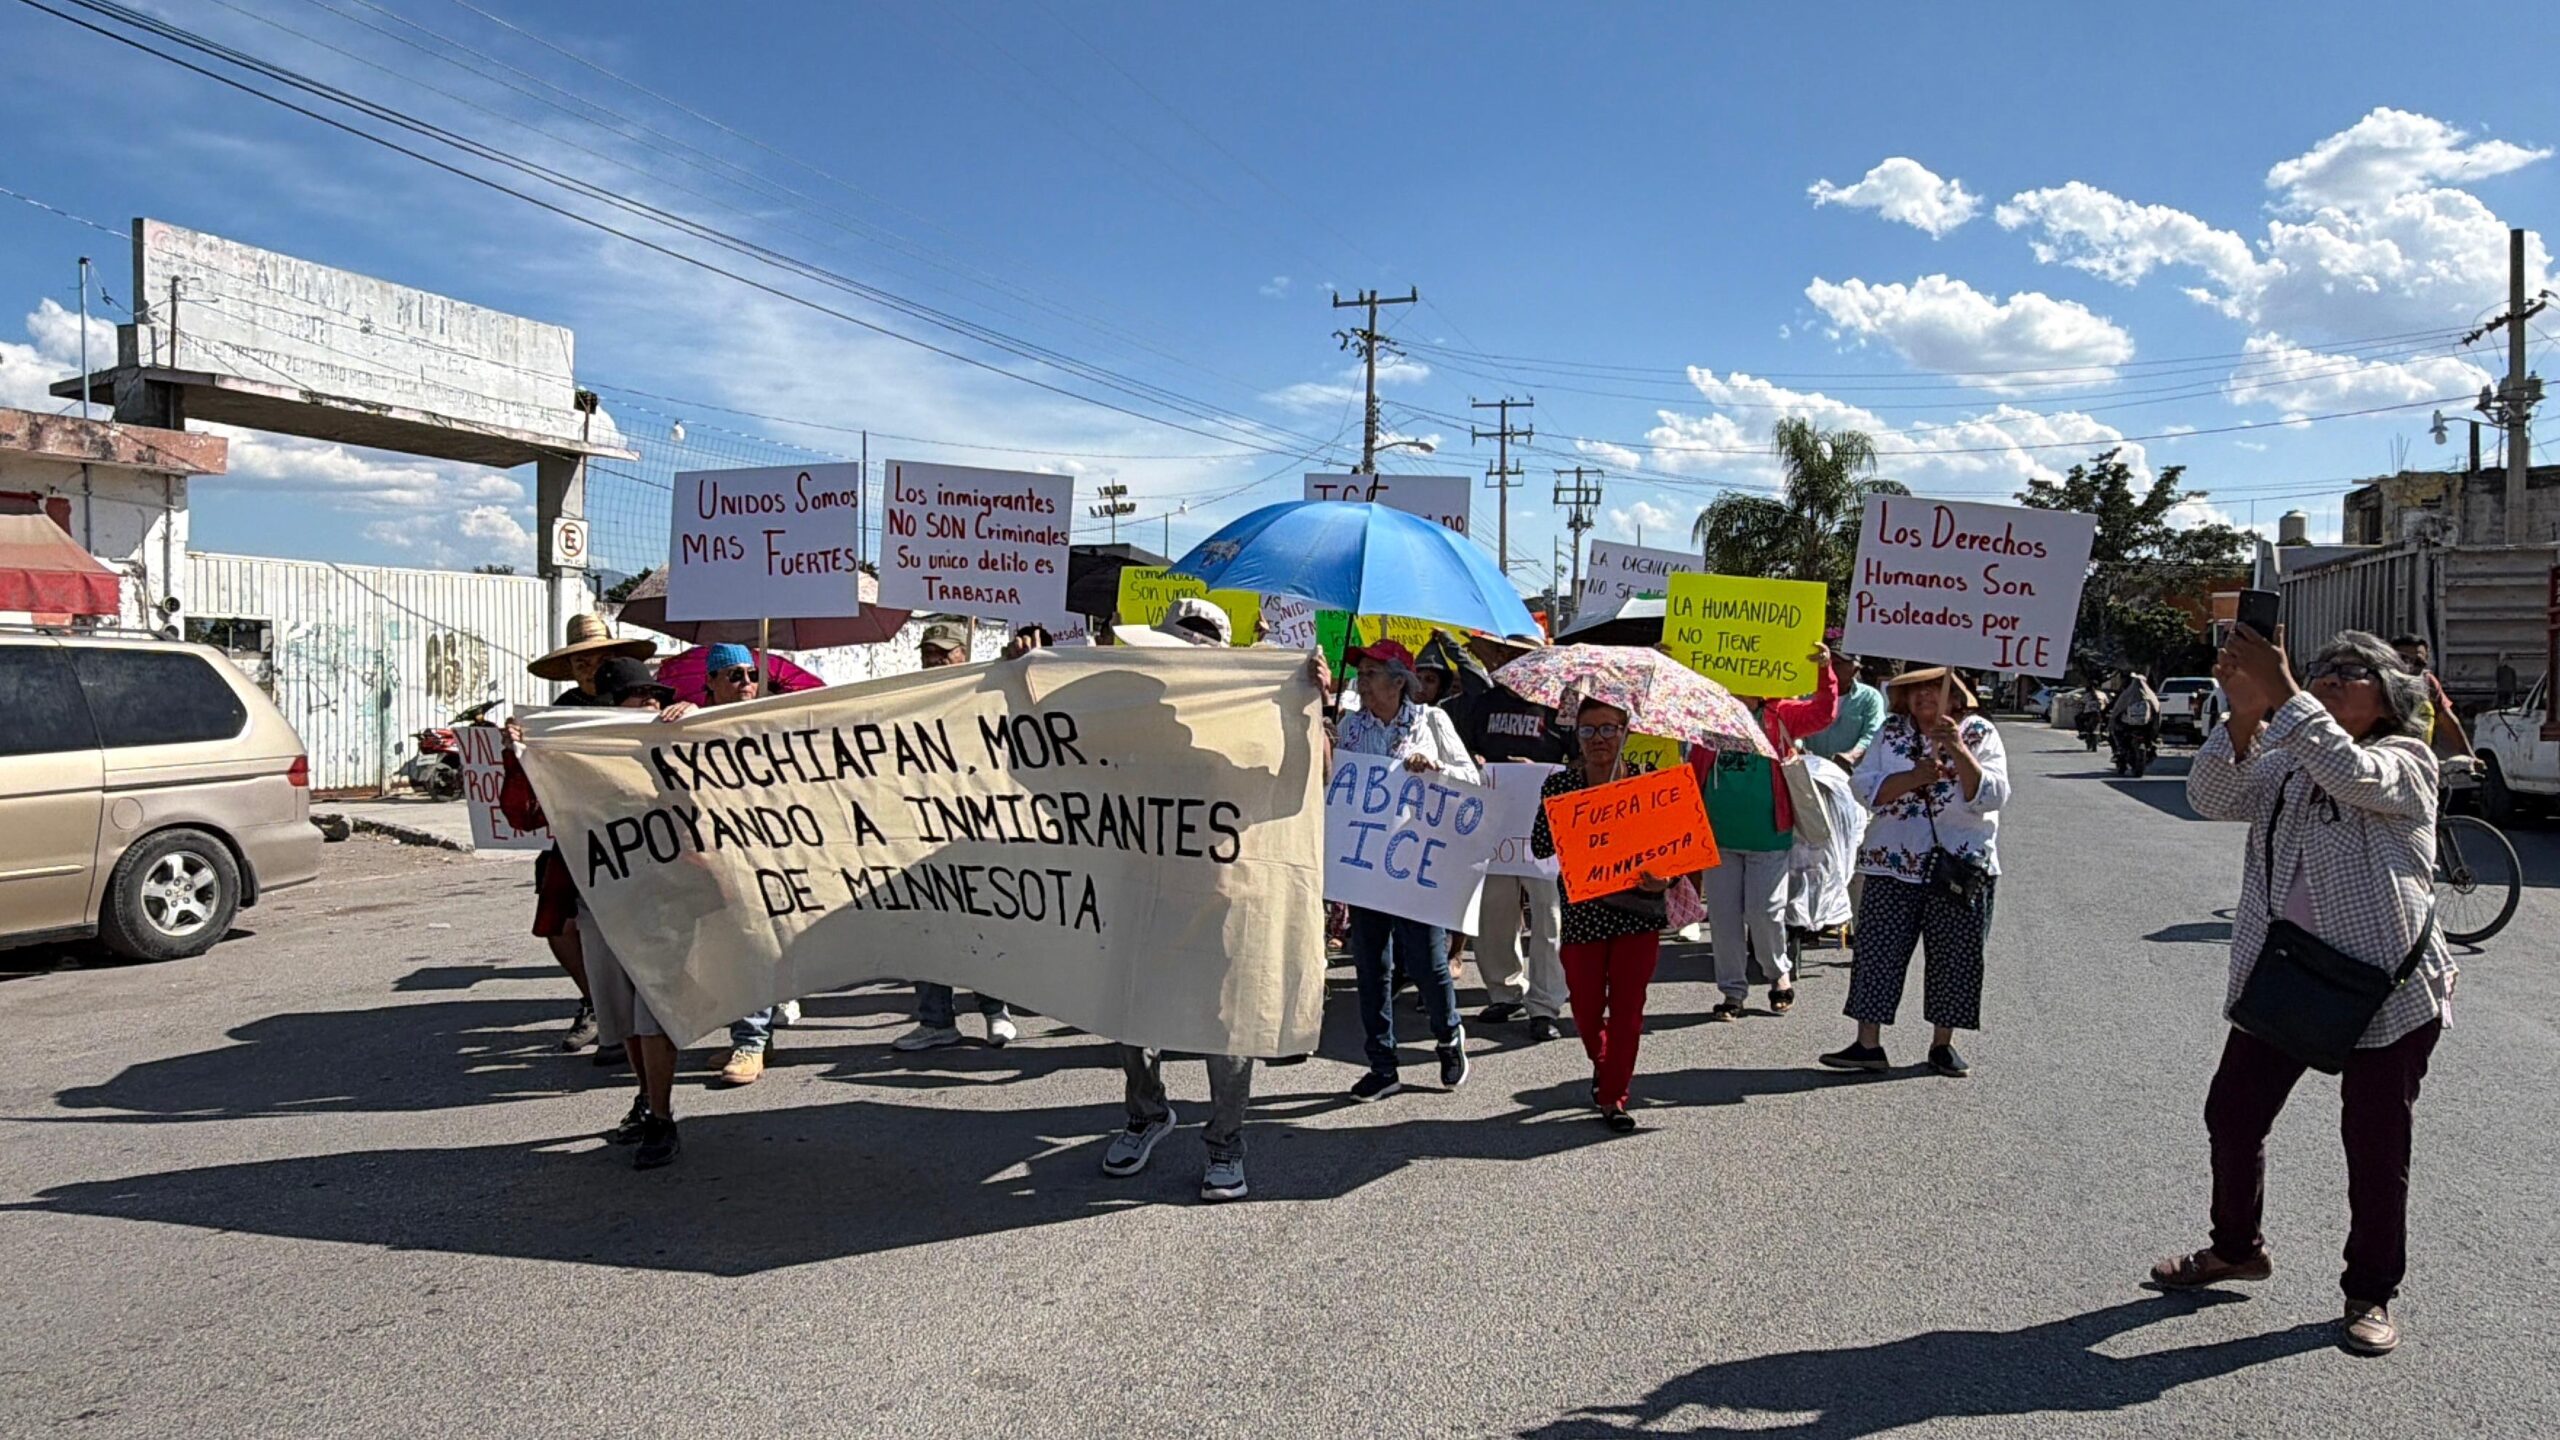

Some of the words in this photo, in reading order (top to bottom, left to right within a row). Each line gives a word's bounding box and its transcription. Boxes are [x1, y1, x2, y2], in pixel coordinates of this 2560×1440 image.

[699, 479, 786, 520] UNIDOS
[895, 466, 928, 505] Los
[937, 483, 1055, 517] inmigrantes
[889, 508, 917, 537] NO
[926, 512, 966, 539] SON
[975, 512, 1070, 546] Criminales
[1879, 501, 1922, 548] Los
[1931, 505, 2047, 559] Derechos
[682, 533, 745, 565] MAS
[762, 529, 857, 576] FUERTES
[897, 545, 921, 568] Su
[929, 550, 969, 569] unico
[978, 549, 1028, 573] delito
[1035, 558, 1055, 574] es
[1589, 551, 1608, 567] LA
[922, 576, 1021, 605] TRABAJAR
[1588, 577, 1607, 596] NO
[1865, 557, 1968, 592] Humanos
[1983, 563, 2036, 597] Son
[1674, 595, 1693, 617] LA
[1703, 598, 1802, 629] HUMANIDAD
[1856, 590, 1974, 629] Pisoteados
[1982, 613, 2021, 637] por
[1677, 627, 1703, 645] NO
[1717, 631, 1762, 653] TIENE
[1992, 635, 2050, 668] ICE
[1691, 650, 1798, 682] FRONTERAS
[1487, 712, 1543, 738] MARVEL
[1326, 761, 1485, 836] ABAJO
[1571, 794, 1641, 829] FUERA
[1651, 786, 1682, 810] ICE
[587, 804, 825, 888] APOYANDO
[851, 801, 887, 847] A
[903, 791, 1242, 864] INMIGRANTES
[1339, 820, 1448, 889] ICE
[1586, 831, 1693, 883] MINNESOTA
[1588, 832, 1610, 849] DE
[756, 868, 826, 918] DE
[840, 863, 1101, 934] MINNESOTA
